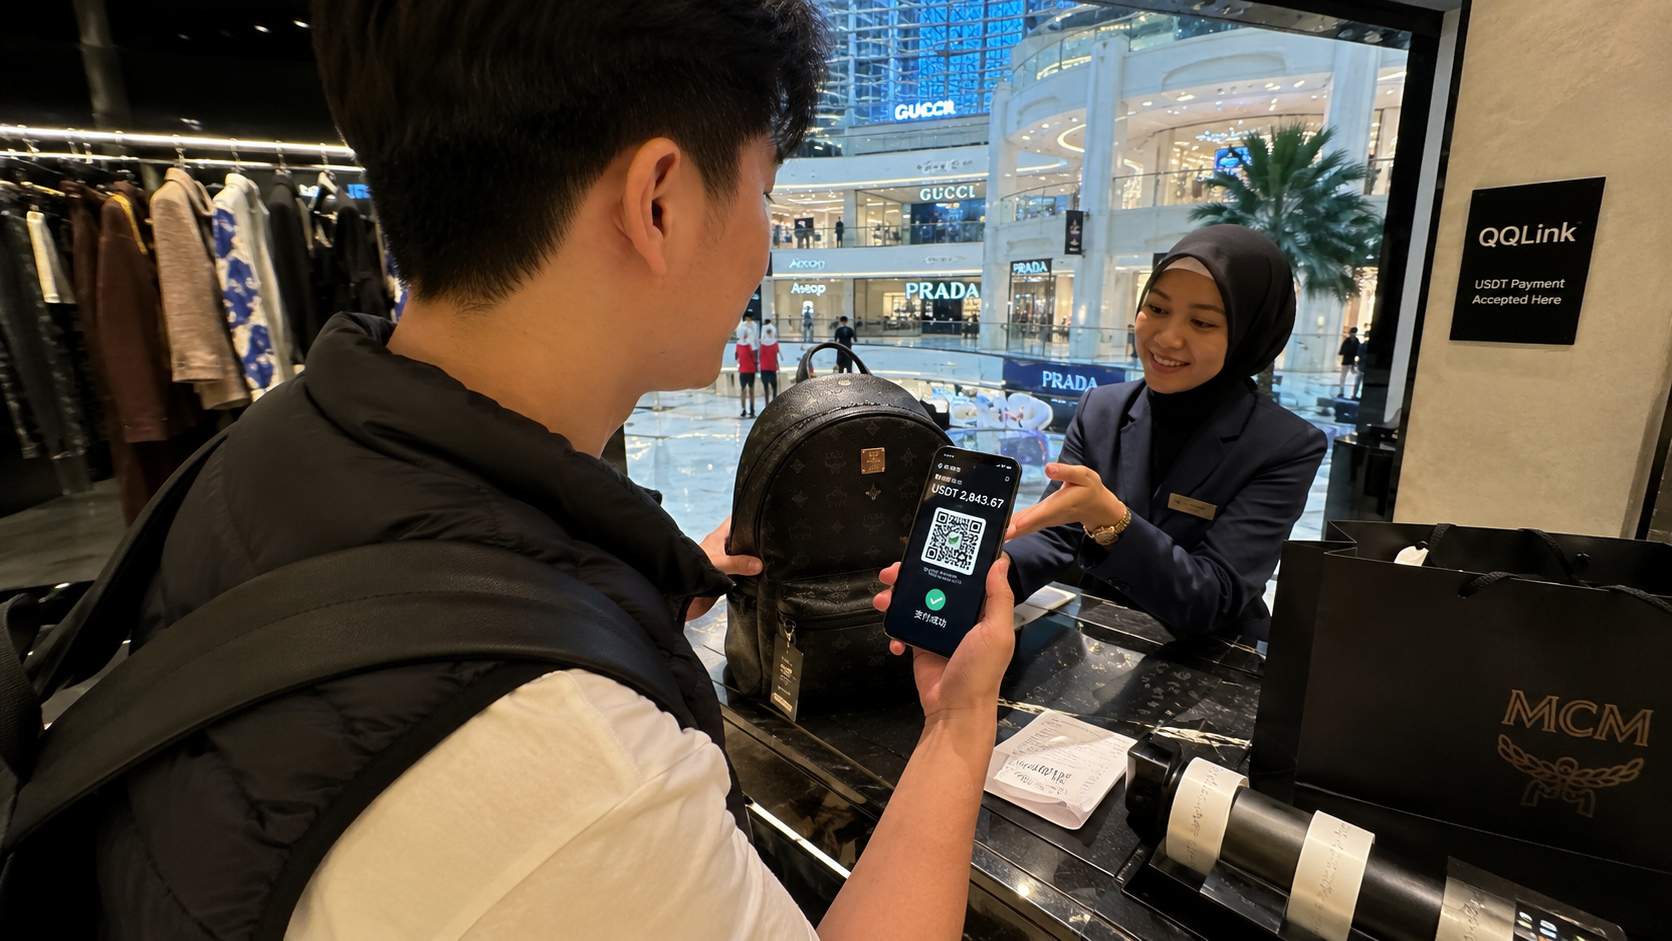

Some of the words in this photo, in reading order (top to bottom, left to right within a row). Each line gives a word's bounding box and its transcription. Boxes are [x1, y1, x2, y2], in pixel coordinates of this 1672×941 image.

[1478, 221, 1577, 248] QQLink
[1012, 261, 1048, 274] PRADA
[905, 281, 980, 300] PRADA
[1474, 279, 1509, 290] USDT
[1510, 278, 1566, 291] Payment
[1471, 294, 1529, 306] Accepted
[1531, 294, 1562, 305] Here
[1041, 370, 1098, 392] PRADA
[931, 483, 959, 498] USDT
[959, 490, 1005, 509] 2,843.67
[1501, 689, 1654, 747] MCM
